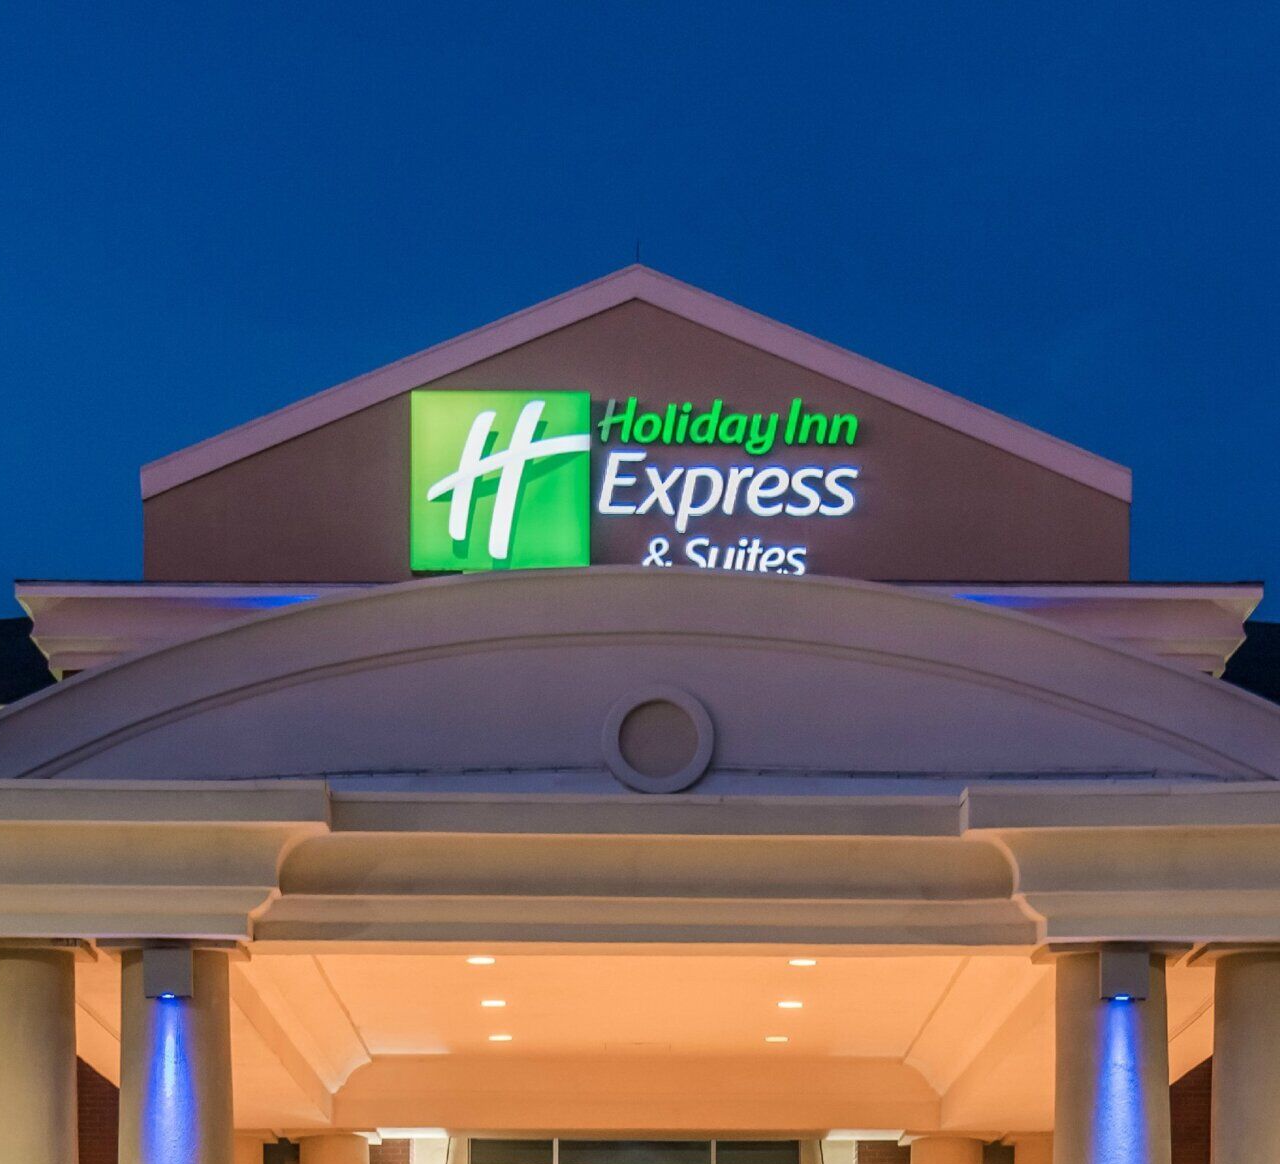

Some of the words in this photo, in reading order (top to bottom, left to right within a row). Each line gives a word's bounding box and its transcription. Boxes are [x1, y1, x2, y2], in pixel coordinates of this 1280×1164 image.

[598, 397, 778, 454] Holiday
[785, 398, 858, 445] Inn
[598, 450, 858, 533] Express
[642, 536, 673, 567] &
[684, 536, 807, 575] Suites
